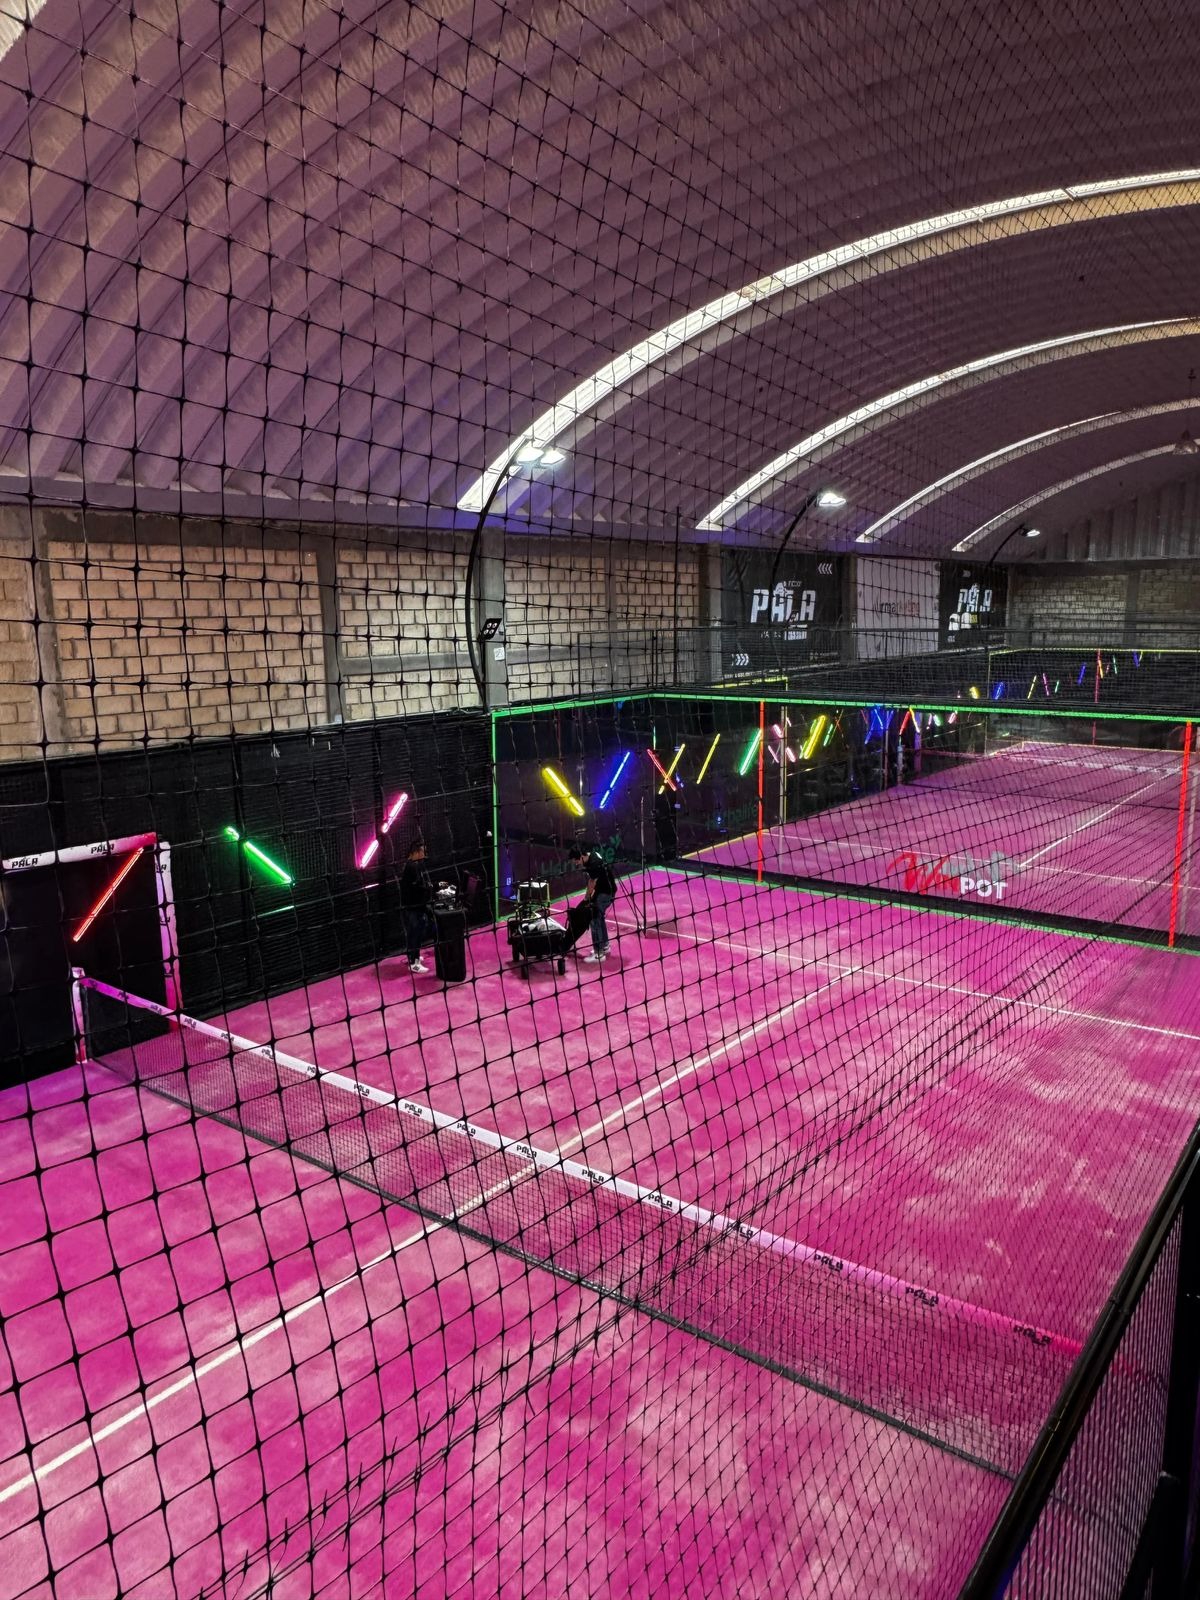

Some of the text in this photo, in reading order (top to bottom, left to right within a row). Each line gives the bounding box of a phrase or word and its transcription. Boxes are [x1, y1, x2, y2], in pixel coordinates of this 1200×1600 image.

[750, 584, 816, 623] PALA
[957, 584, 992, 612] PALA
[11, 857, 39, 869] PALA
[404, 1103, 423, 1116] PALA
[457, 1122, 476, 1137] PALA
[516, 1144, 538, 1159] PALA
[581, 1169, 605, 1184] PALA
[648, 1193, 674, 1210] PALA
[813, 1252, 843, 1273] PALA
[905, 1285, 939, 1308] PALA
[1013, 1323, 1051, 1346] PALA
